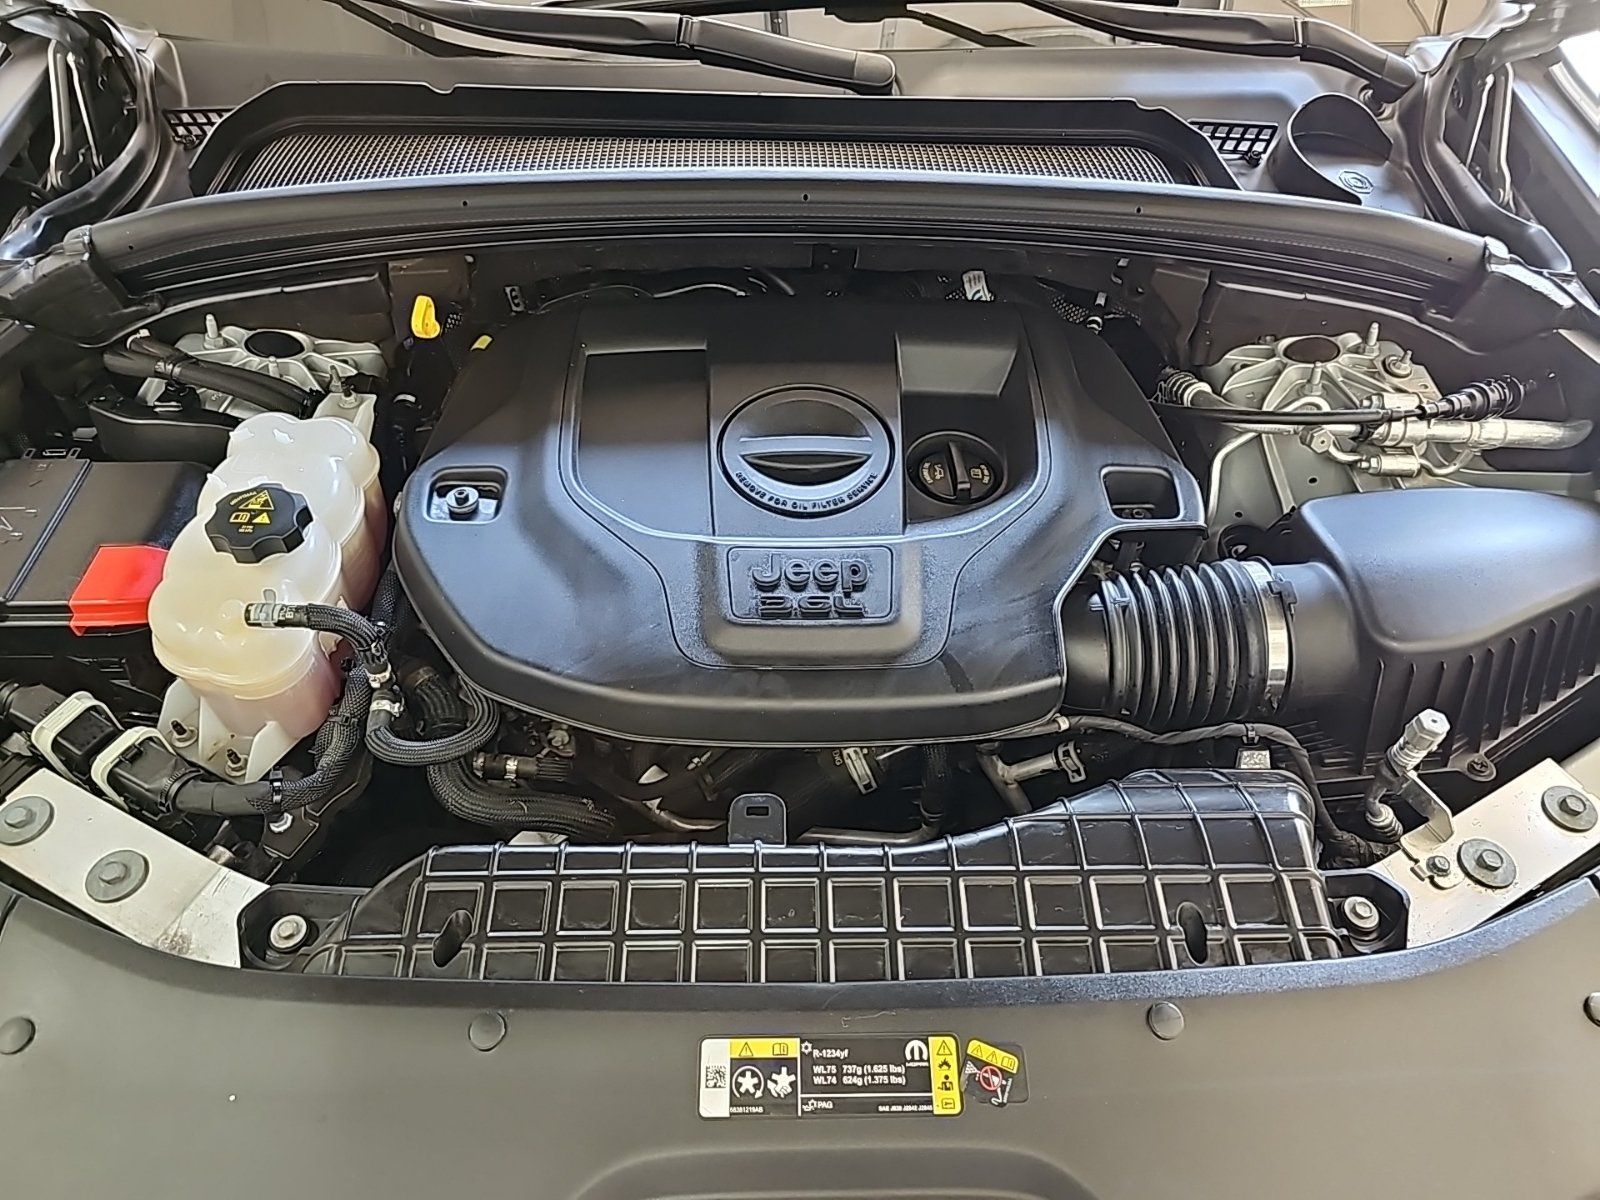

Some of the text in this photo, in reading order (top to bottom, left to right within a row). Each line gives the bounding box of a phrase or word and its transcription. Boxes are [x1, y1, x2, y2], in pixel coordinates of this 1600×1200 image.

[768, 495, 787, 507] FOR
[791, 501, 808, 510] OIL
[812, 496, 845, 510] FILTER
[847, 472, 878, 500] SERVICE
[751, 552, 869, 597] Jeep
[812, 1048, 849, 1060] R-1234yf
[812, 1064, 906, 1076] WL75 737g (1.625 lbs)
[812, 1075, 907, 1087] WL74 624g (1.375 lbs)
[817, 1100, 834, 1109] PAG
